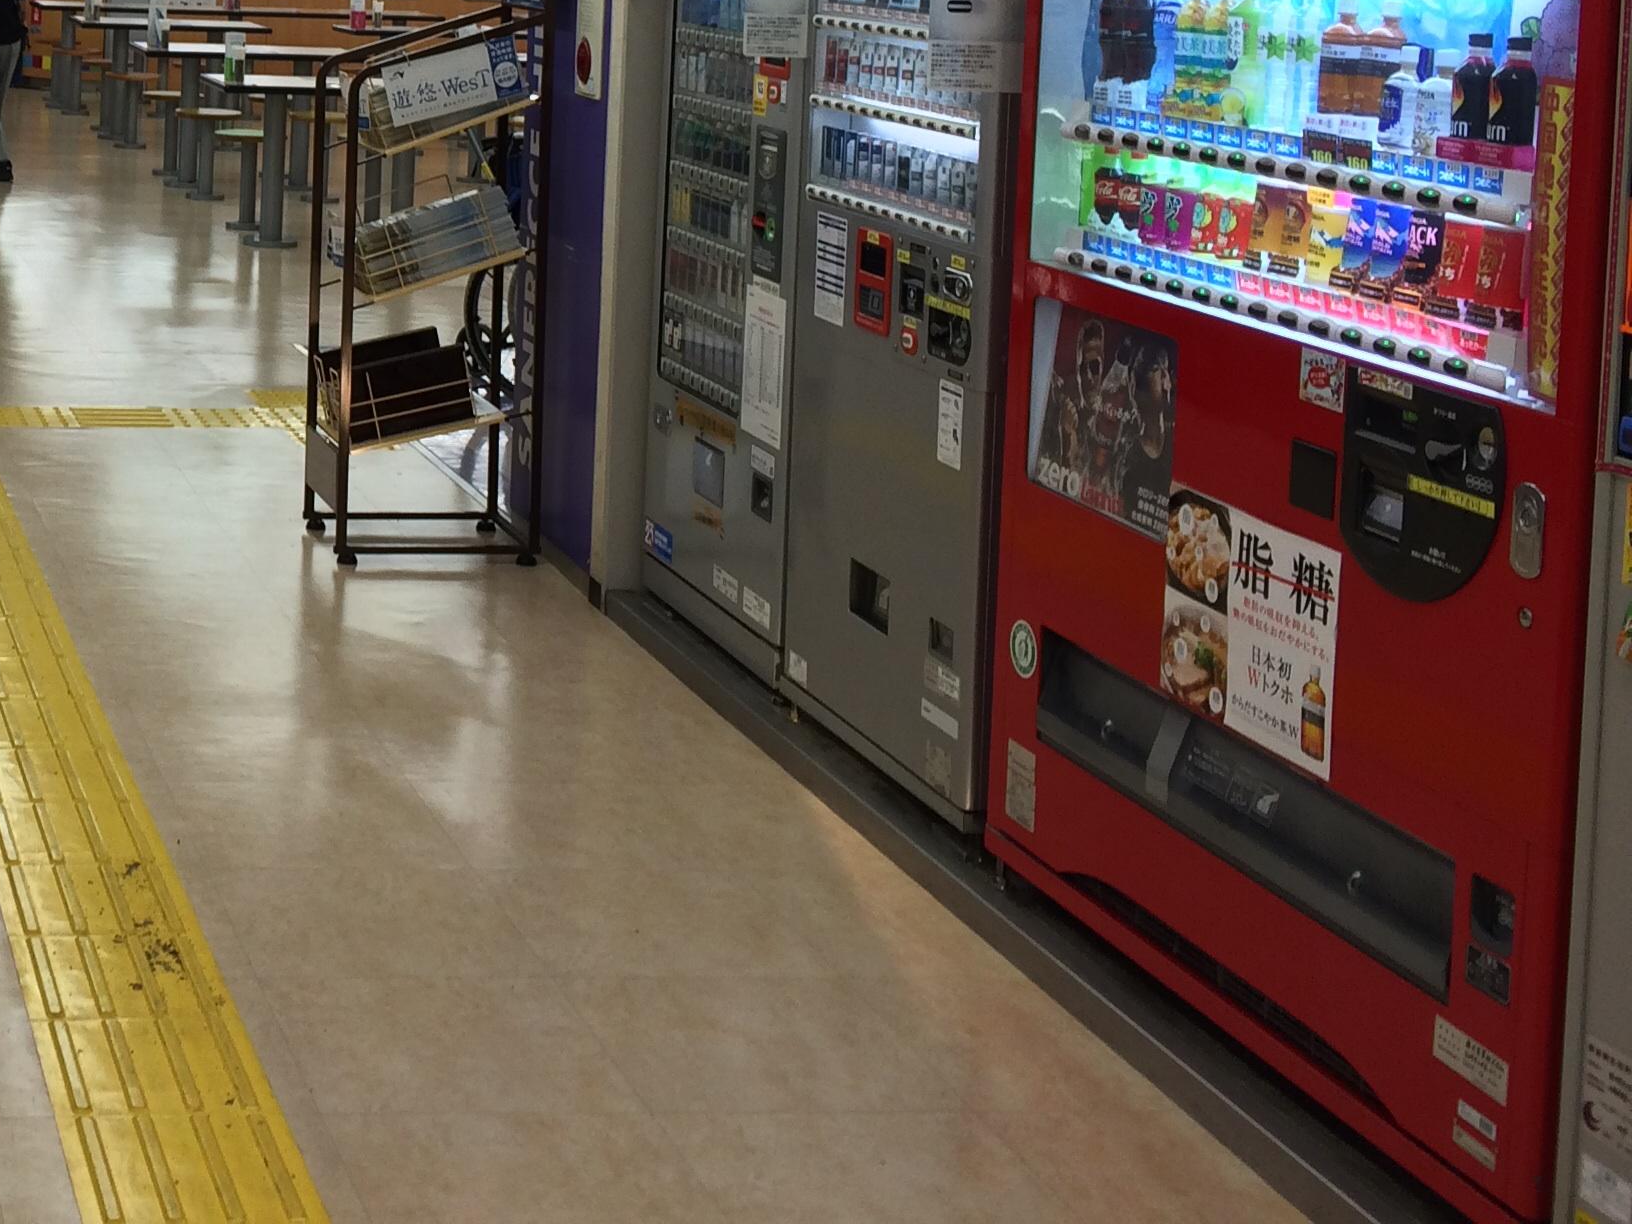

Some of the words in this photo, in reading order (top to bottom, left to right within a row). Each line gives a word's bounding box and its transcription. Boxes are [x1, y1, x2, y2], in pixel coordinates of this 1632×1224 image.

[1311, 149, 1333, 164] 160
[1346, 155, 1369, 171] 160
[1037, 457, 1081, 499] zero
[1232, 528, 1274, 600] 脂
[1289, 552, 1335, 627] 糖
[1251, 644, 1292, 682] 日本初
[1247, 665, 1295, 705] Wトクホ
